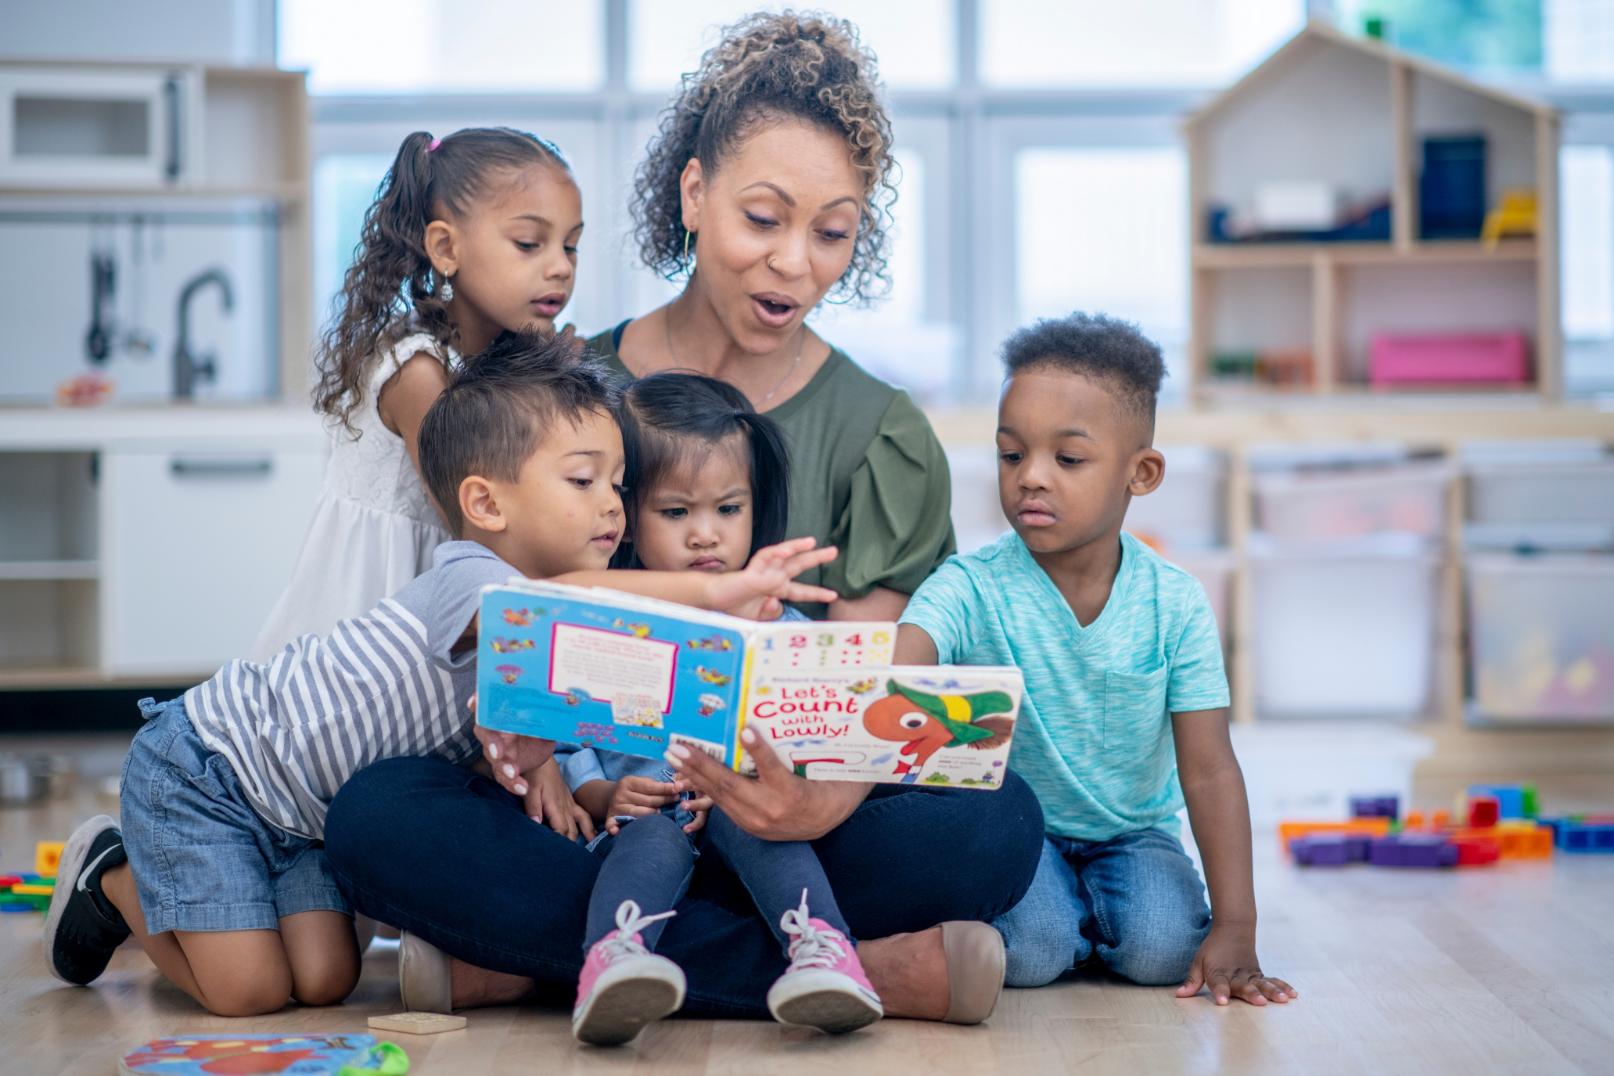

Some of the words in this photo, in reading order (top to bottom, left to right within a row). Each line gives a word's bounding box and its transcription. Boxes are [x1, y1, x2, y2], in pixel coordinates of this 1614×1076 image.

[763, 637, 773, 651] 1
[788, 635, 807, 648] 2
[844, 633, 862, 646] 4
[780, 685, 837, 700] Let's
[753, 696, 858, 719] Count
[782, 714, 824, 726] with
[770, 724, 849, 739] Lowly!
